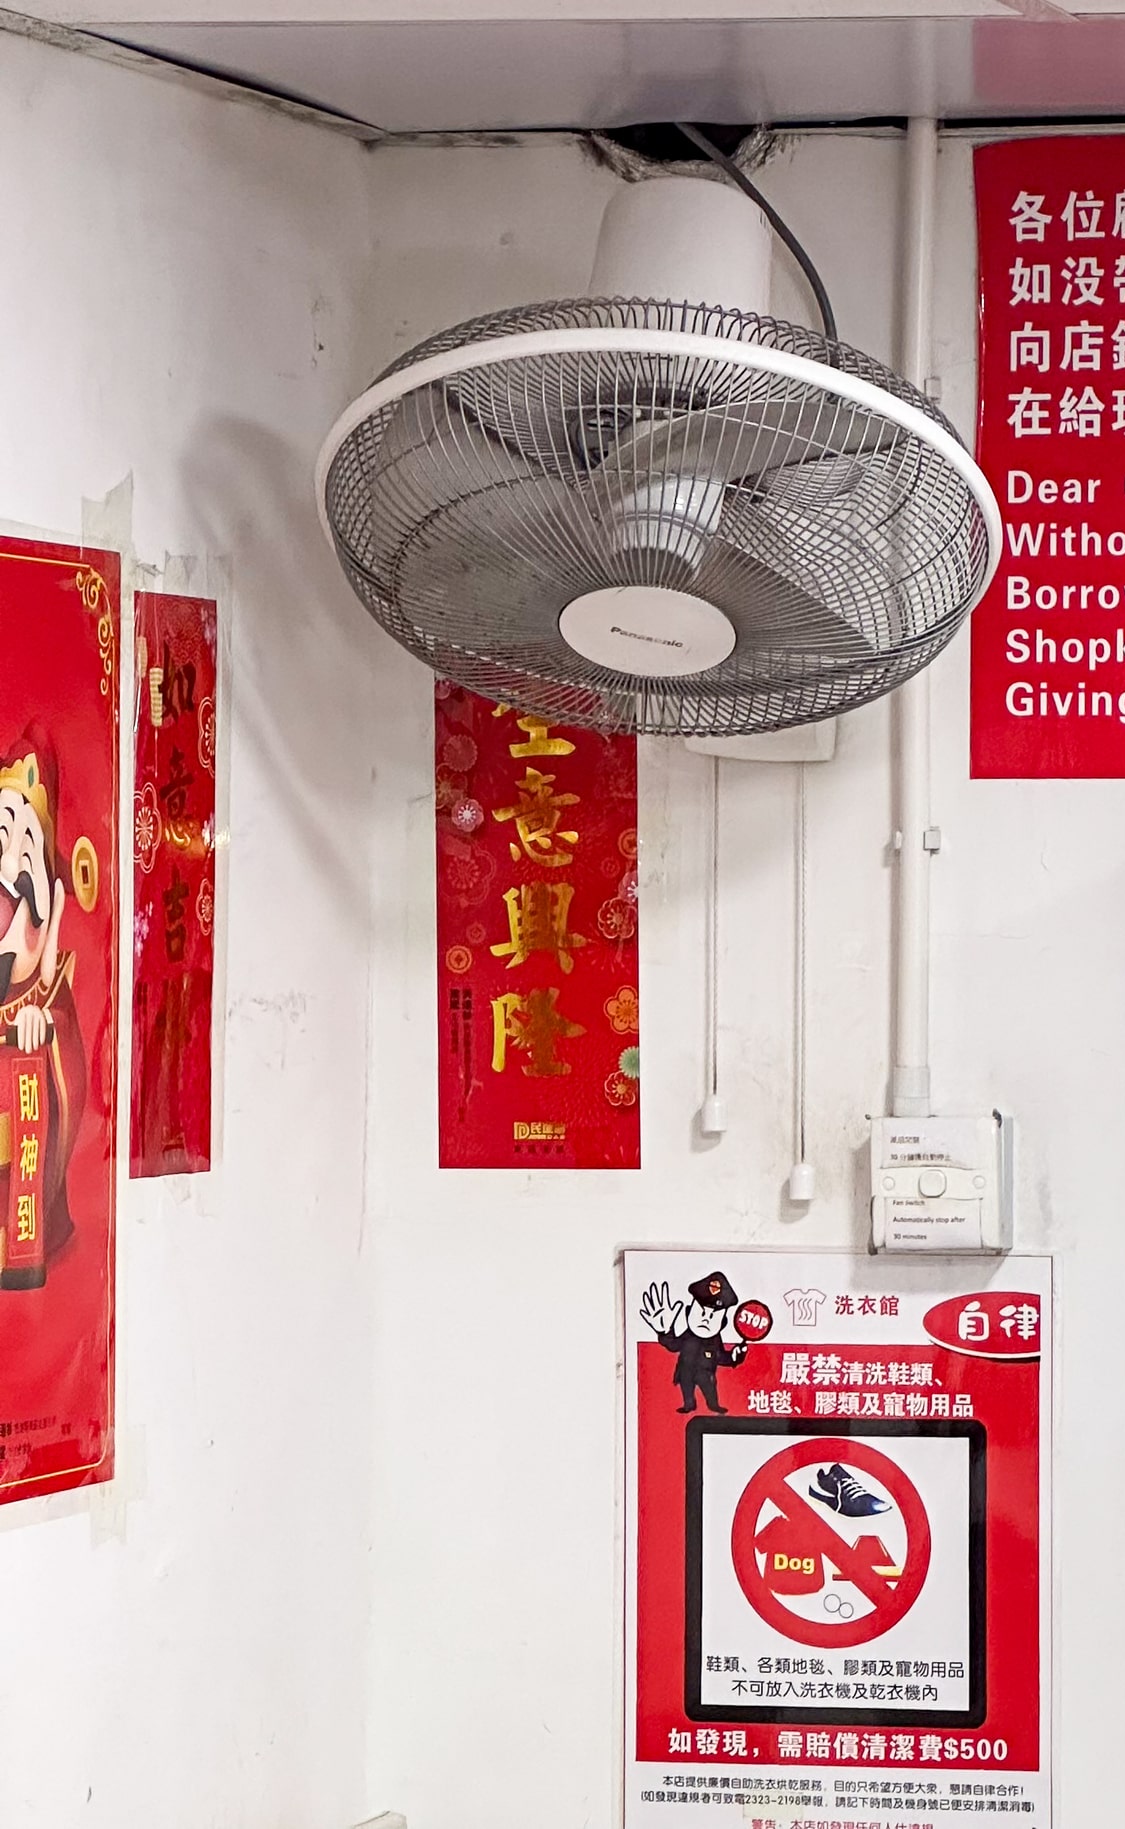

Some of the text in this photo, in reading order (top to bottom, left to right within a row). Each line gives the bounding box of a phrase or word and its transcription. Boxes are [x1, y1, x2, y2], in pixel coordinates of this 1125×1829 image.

[1007, 470, 1100, 503] Dear
[611, 626, 684, 648] Panasonic
[17, 1073, 39, 1241] 財神到
[834, 1295, 900, 1316] 洗衣館
[738, 1309, 769, 1330] STOP
[958, 1301, 1040, 1341] 自律
[774, 1554, 815, 1574] Dog
